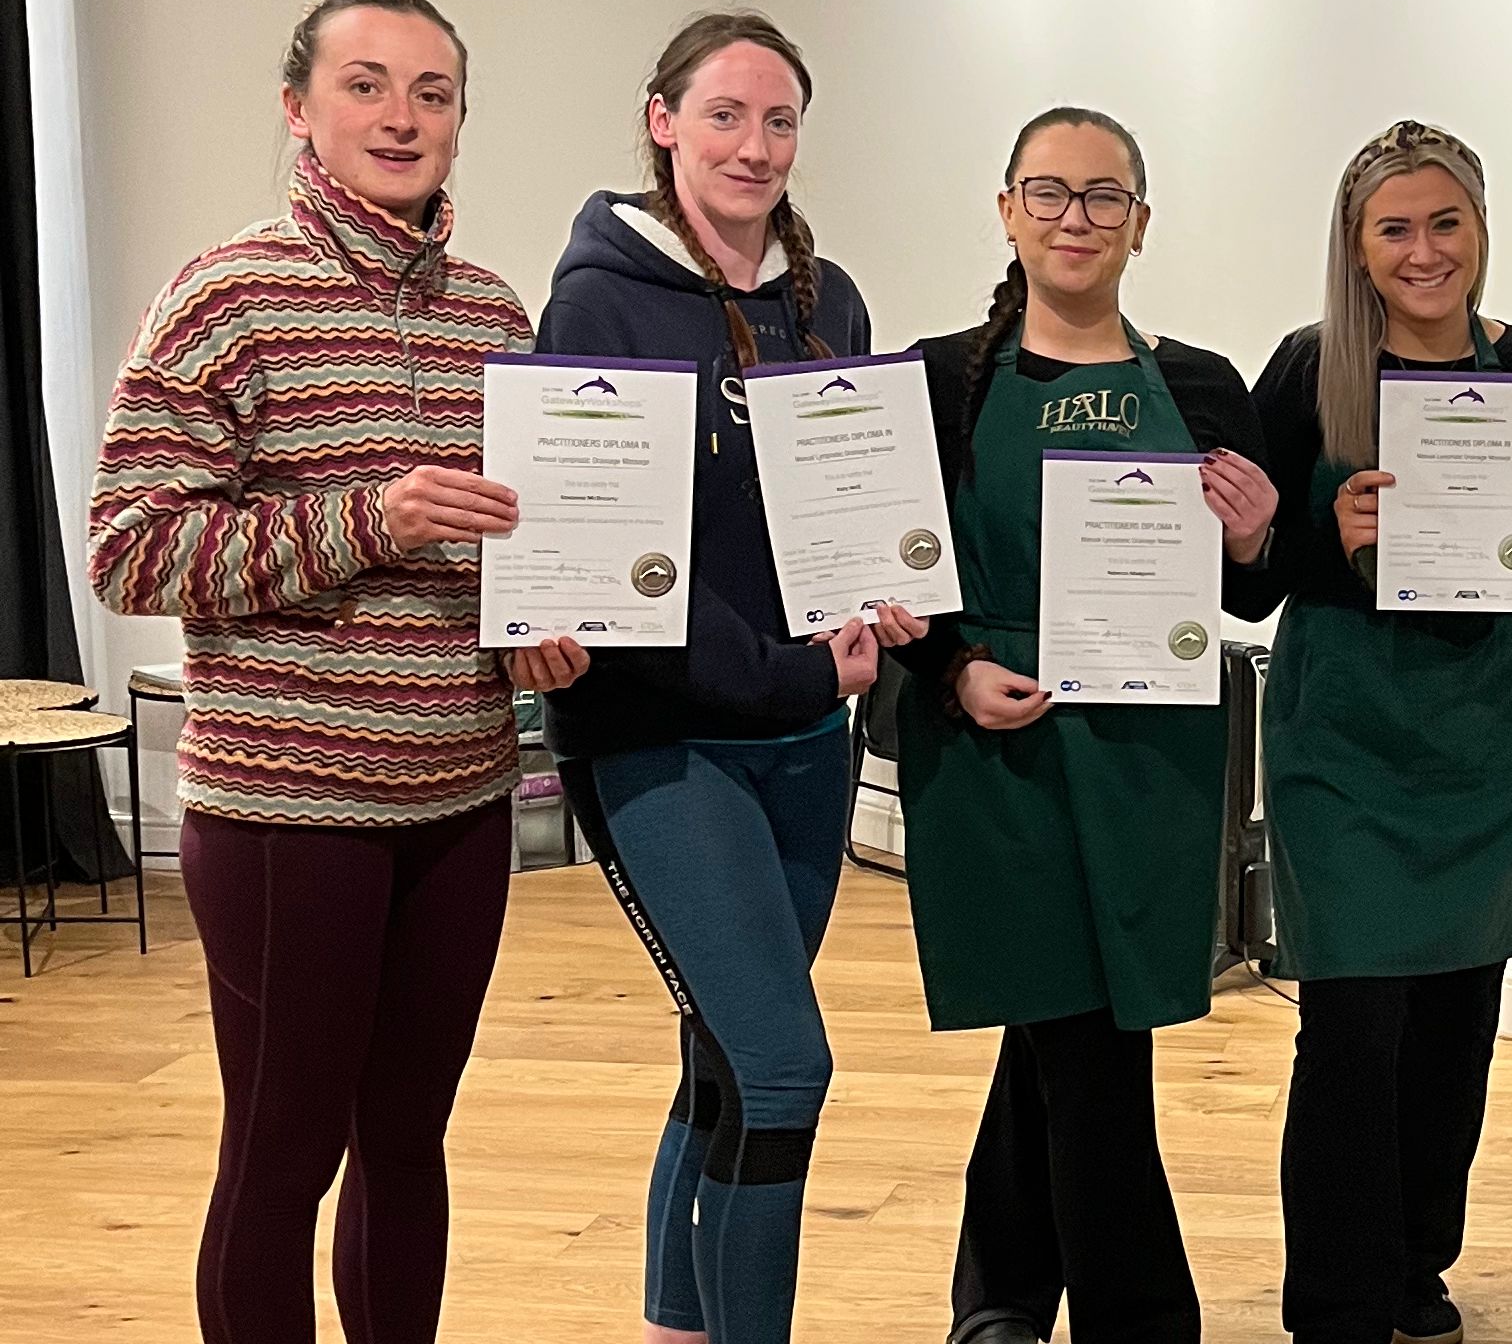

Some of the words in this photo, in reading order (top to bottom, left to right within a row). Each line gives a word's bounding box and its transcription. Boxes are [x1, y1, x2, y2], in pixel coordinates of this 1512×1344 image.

[1036, 389, 1140, 430] HALO
[608, 861, 630, 899] THE
[627, 902, 667, 965] NORTH
[665, 968, 694, 1016] FACE
